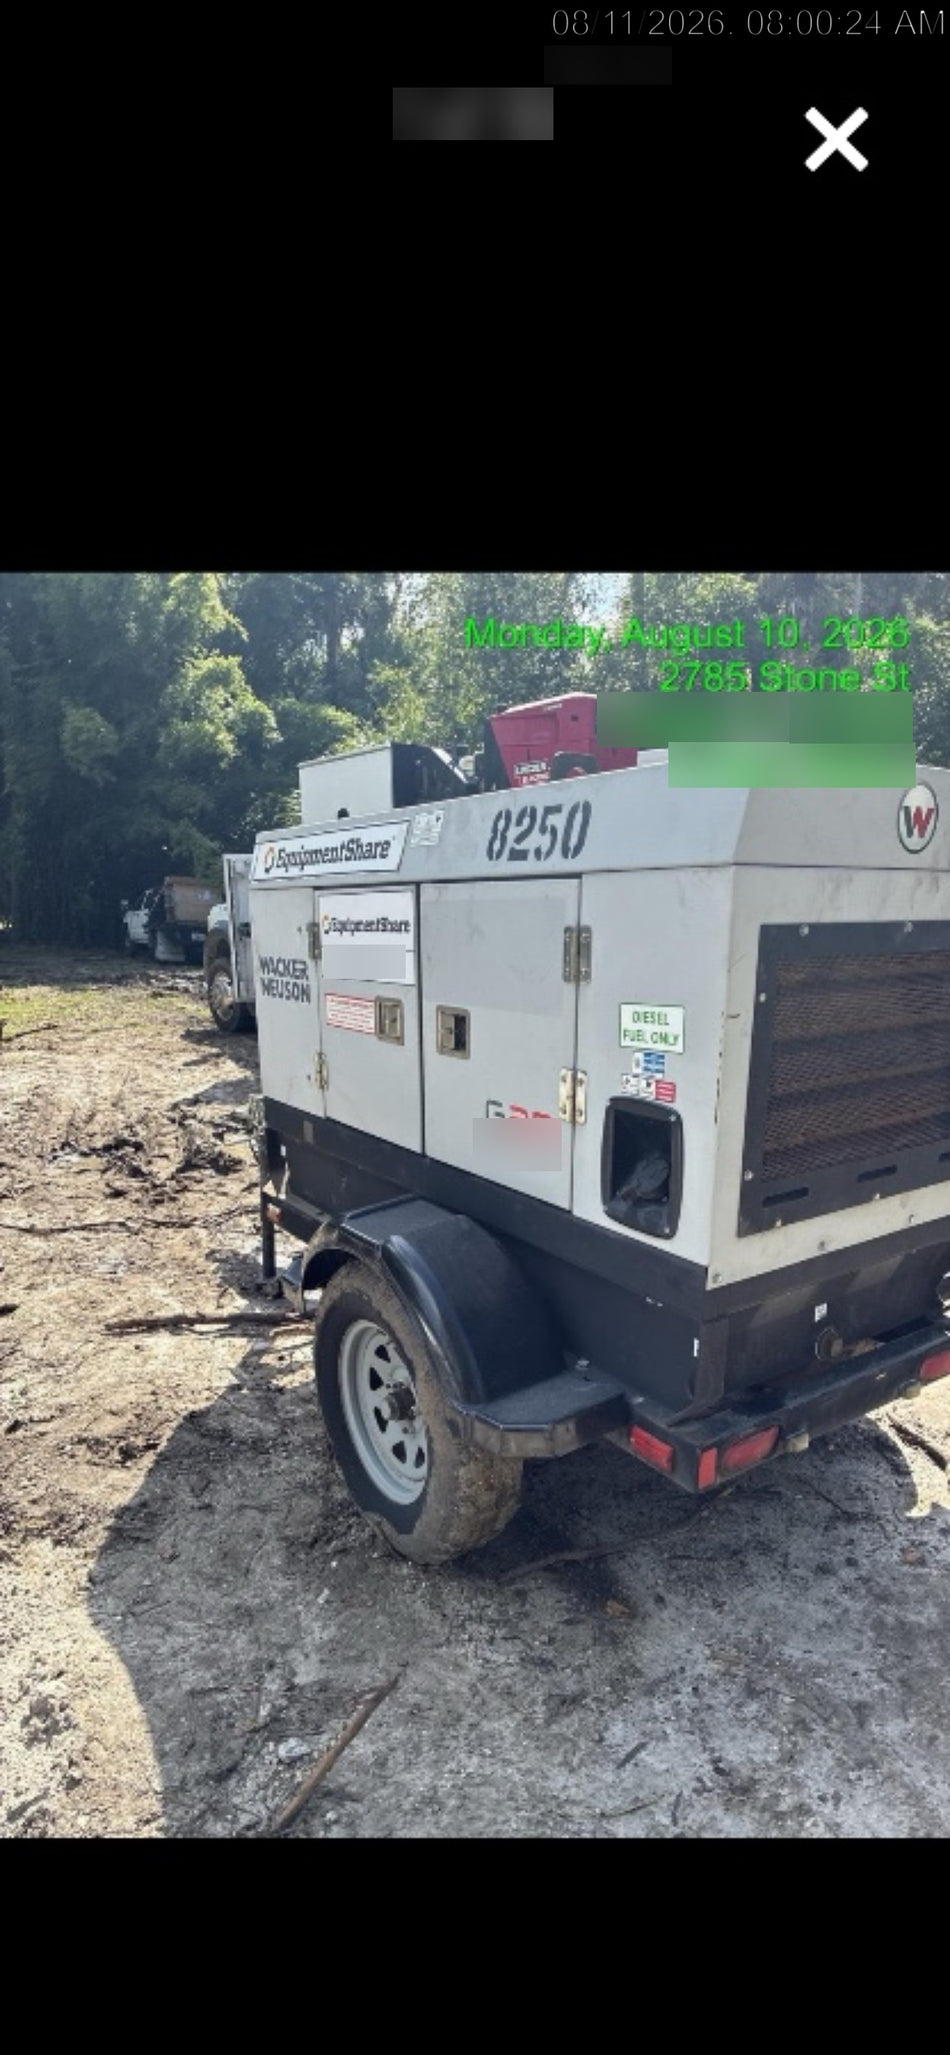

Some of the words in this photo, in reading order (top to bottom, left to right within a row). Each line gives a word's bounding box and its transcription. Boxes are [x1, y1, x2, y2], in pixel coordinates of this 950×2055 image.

[486, 800, 592, 861] 8250
[276, 838, 391, 872] EquipmentShare
[329, 916, 411, 936] EquipmentShare
[259, 956, 309, 980] WACKER
[261, 977, 311, 1005] NEUSON
[632, 1010, 670, 1026] DIESEL
[623, 1028, 649, 1044] FUEL
[651, 1031, 680, 1046] ONLY
